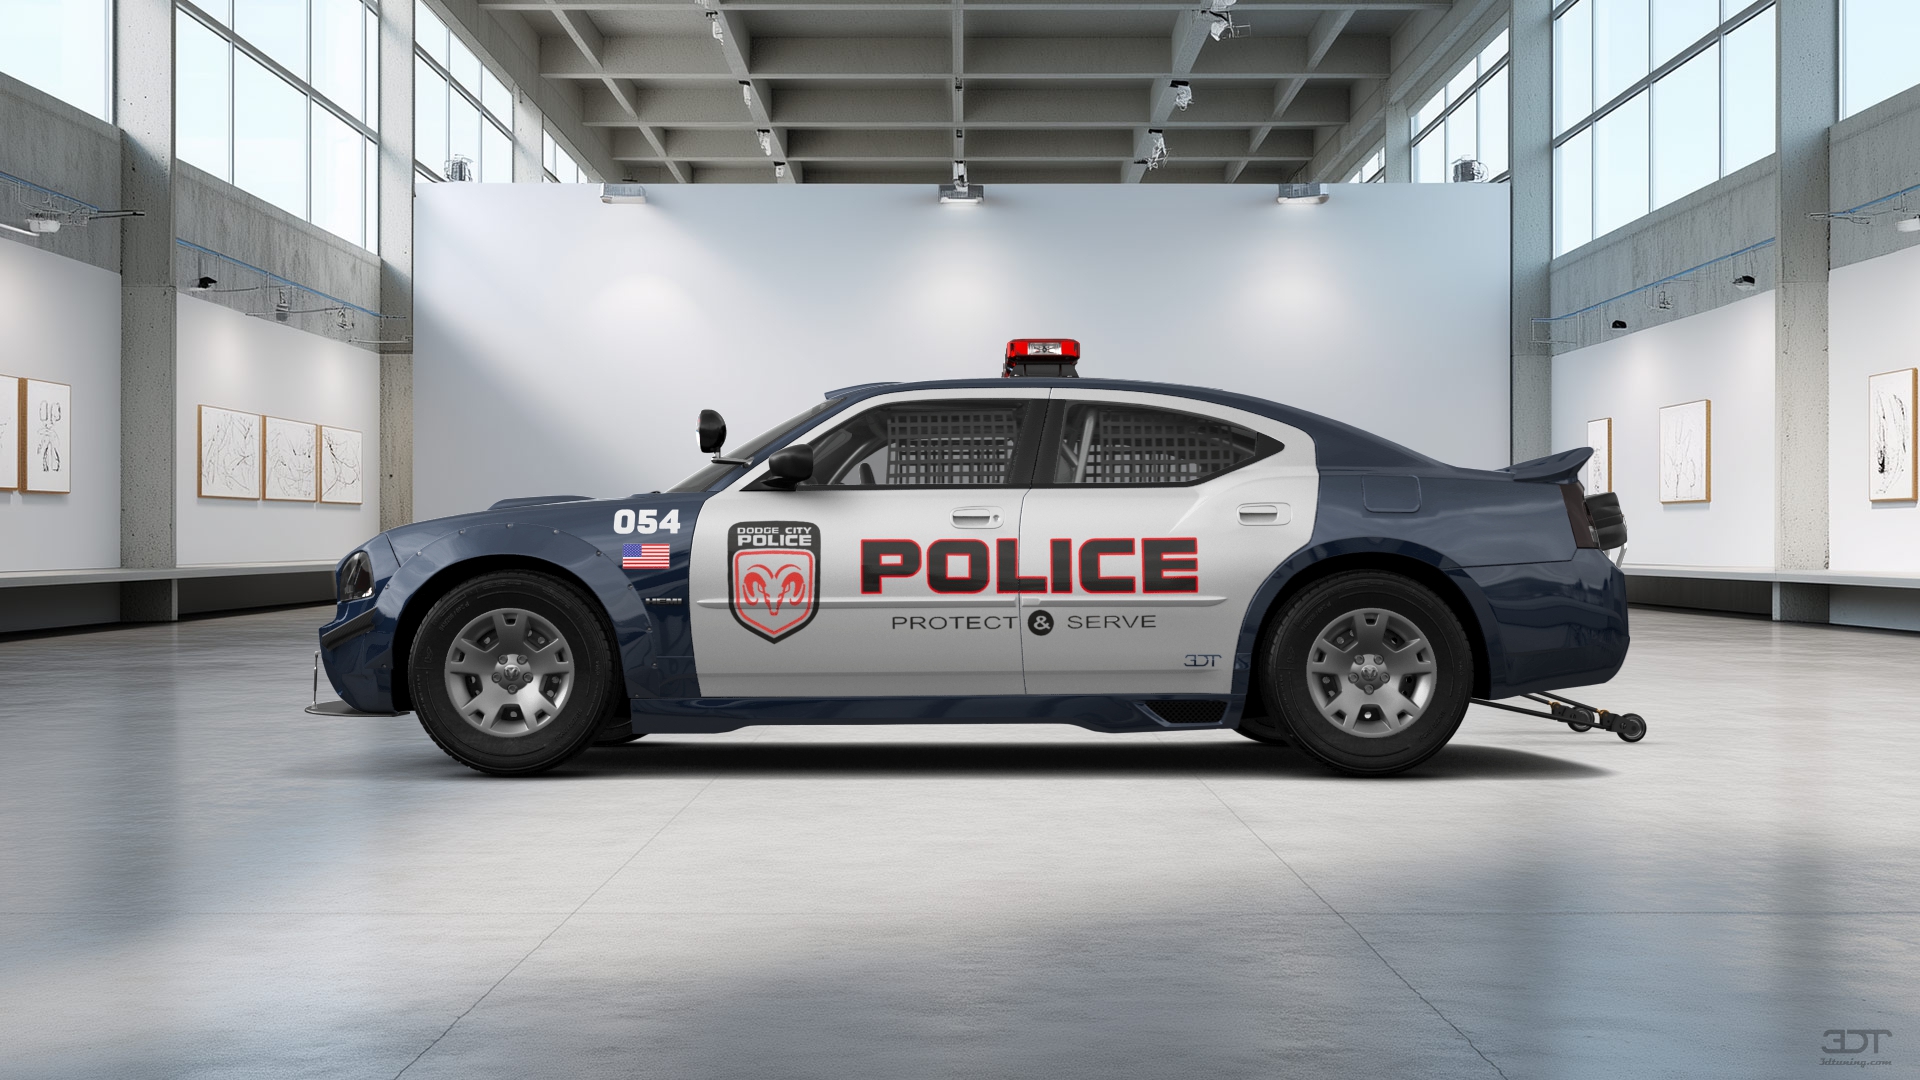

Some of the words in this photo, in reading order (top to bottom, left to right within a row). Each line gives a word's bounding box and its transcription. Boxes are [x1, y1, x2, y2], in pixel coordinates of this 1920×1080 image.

[613, 509, 681, 534] 054
[737, 526, 779, 534] DODGE
[785, 526, 812, 534] CITY
[737, 534, 812, 547] POLICE
[860, 537, 1199, 594] POLICE
[891, 615, 1019, 630] PROTECT
[1067, 614, 1157, 629] SERVE
